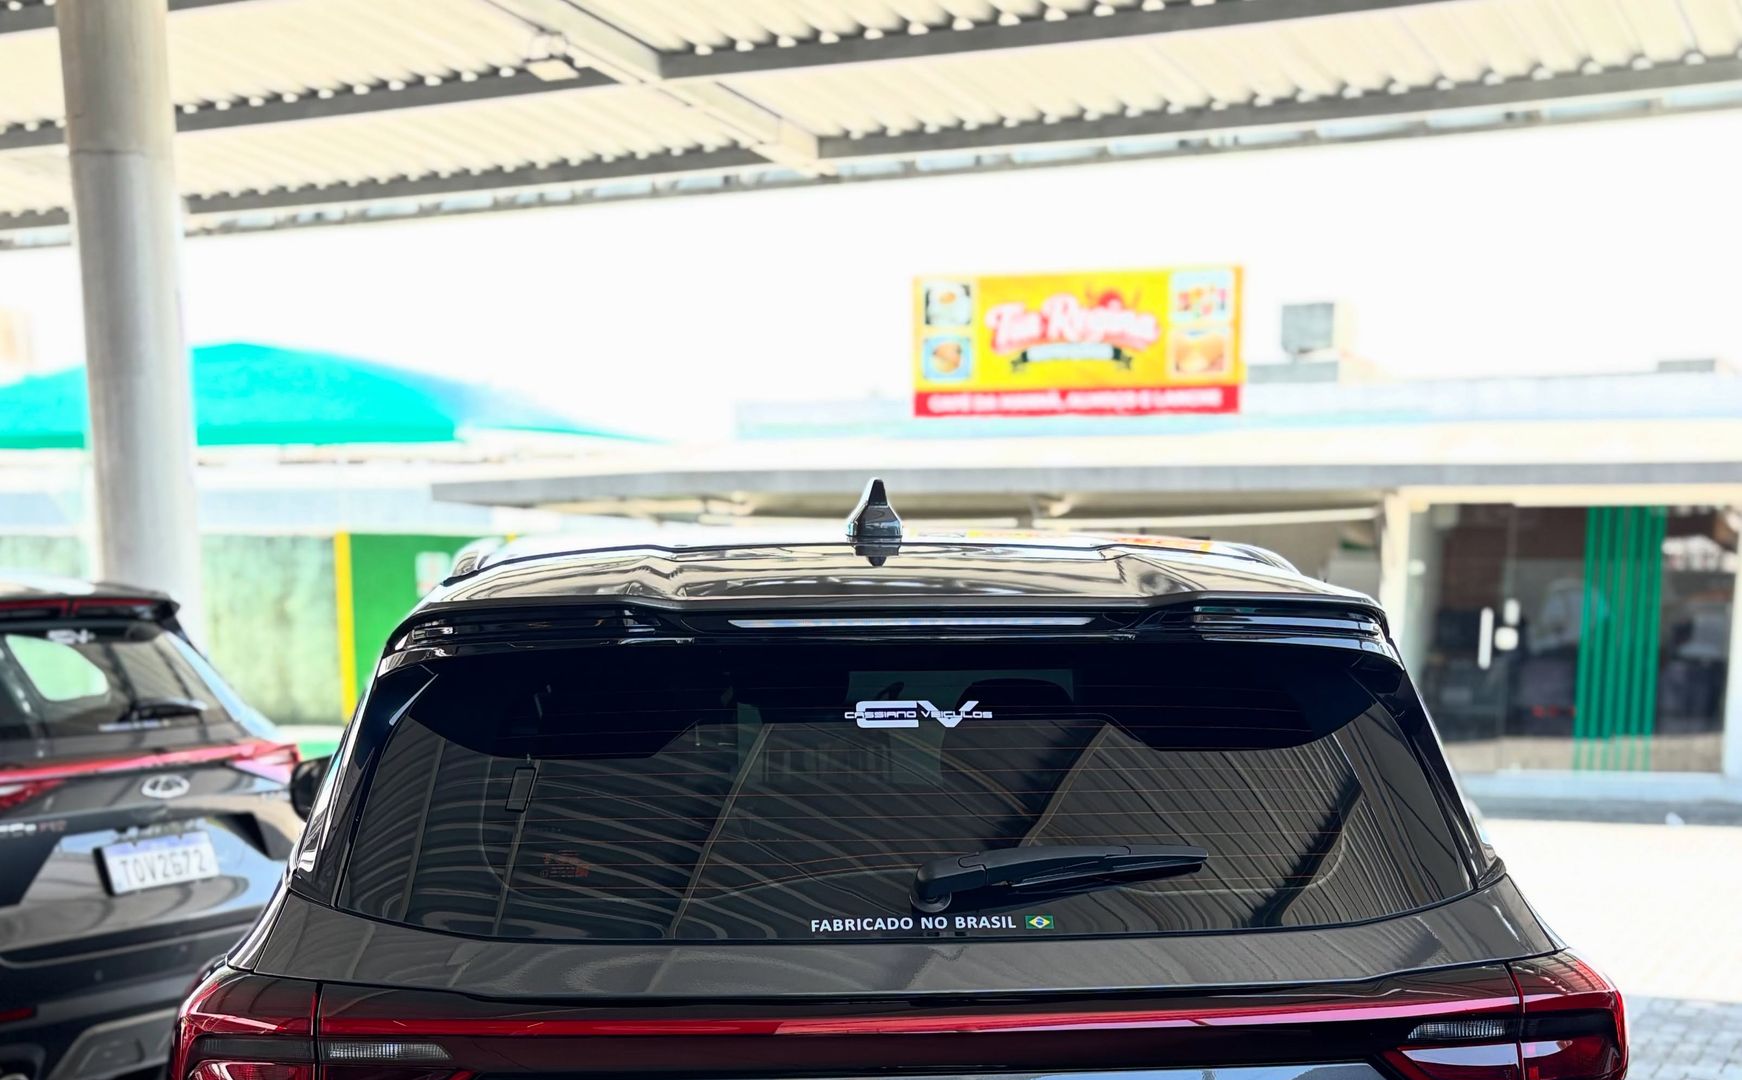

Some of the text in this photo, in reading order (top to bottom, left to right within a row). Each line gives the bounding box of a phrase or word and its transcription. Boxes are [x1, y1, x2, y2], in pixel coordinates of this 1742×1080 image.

[844, 710, 917, 719] CASSIANO
[811, 915, 1016, 932] FABRICADO NO BRASIL
